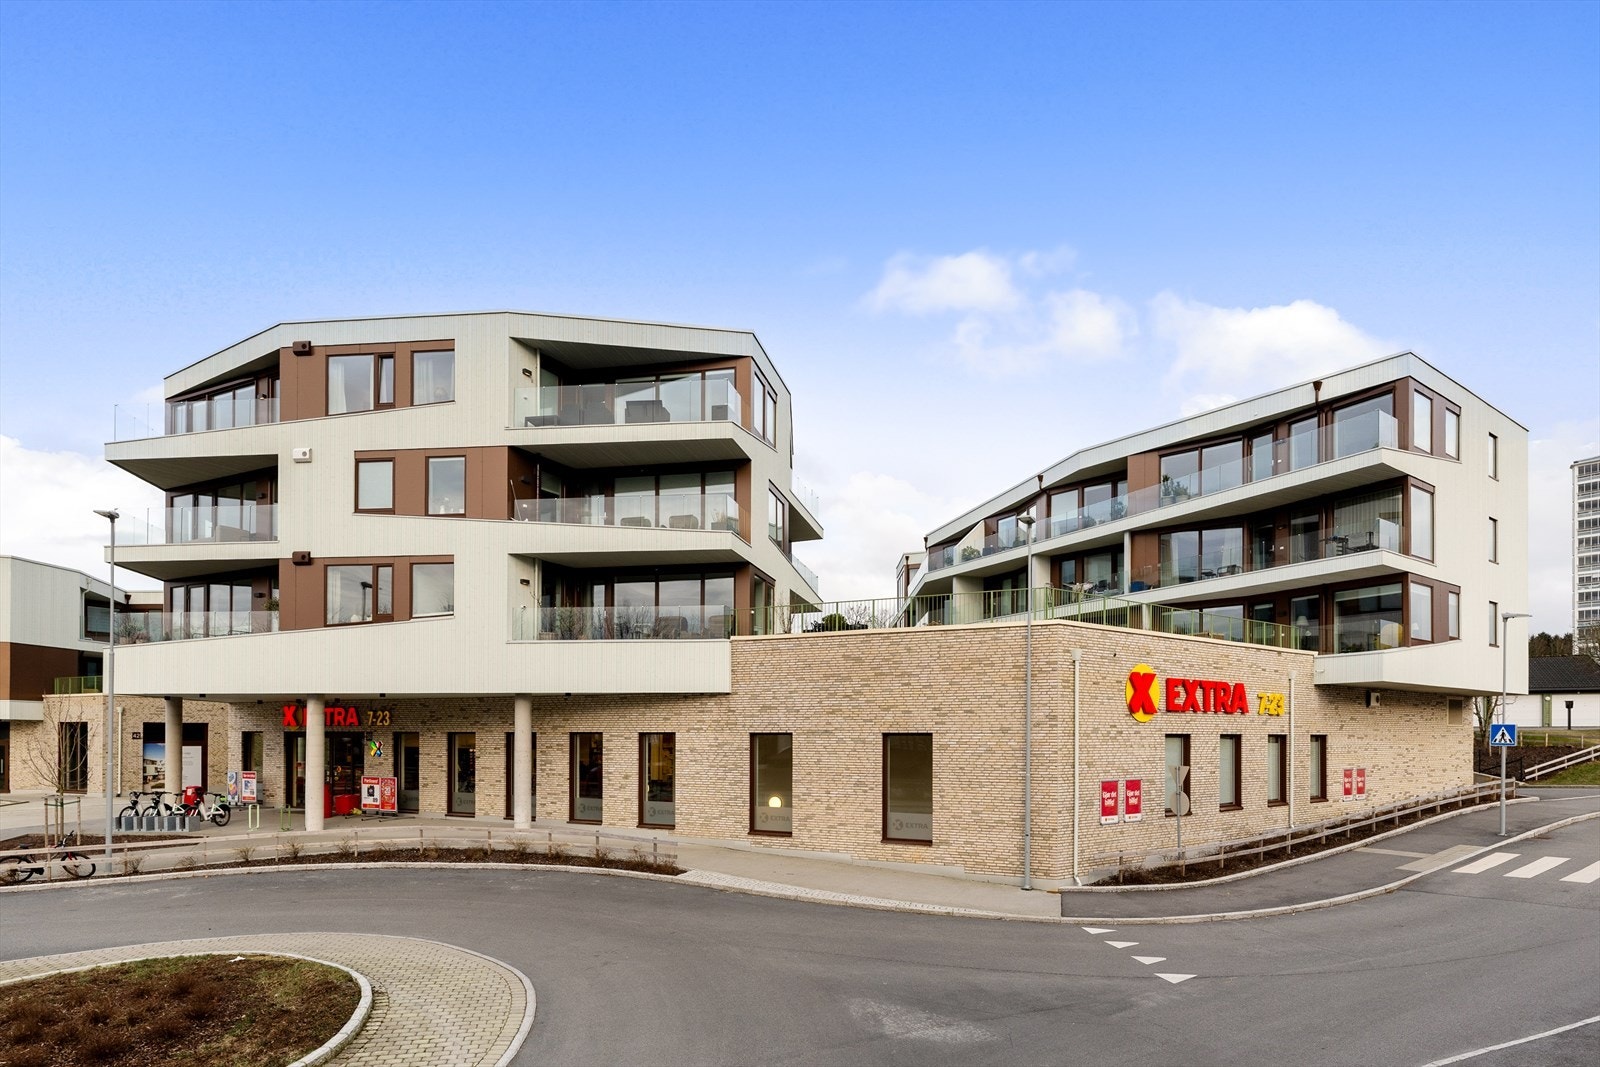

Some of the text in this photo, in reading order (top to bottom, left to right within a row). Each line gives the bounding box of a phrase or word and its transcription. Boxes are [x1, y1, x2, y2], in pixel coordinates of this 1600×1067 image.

[1166, 678, 1249, 714] EXTRA
[1257, 692, 1285, 716] 7-23
[282, 705, 390, 727] X TRA 7-23
